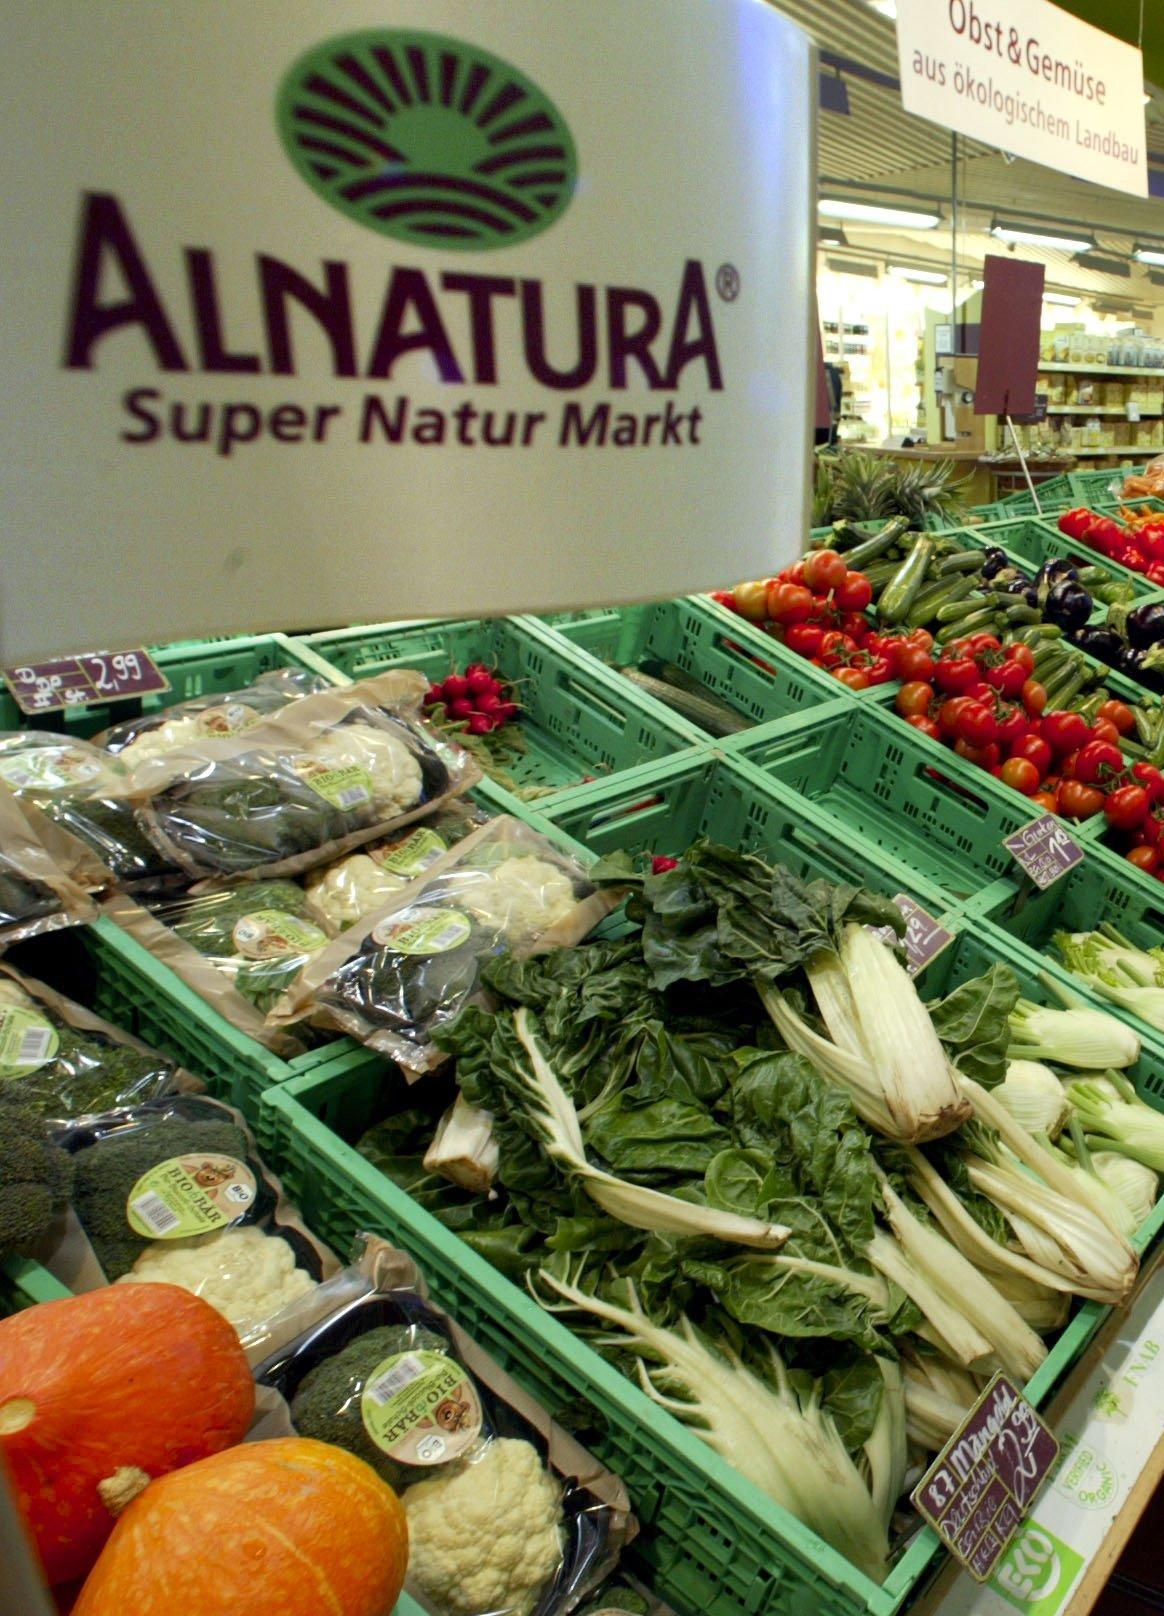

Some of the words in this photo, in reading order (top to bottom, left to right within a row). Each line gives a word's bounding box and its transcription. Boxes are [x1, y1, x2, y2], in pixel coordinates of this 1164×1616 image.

[913, 49, 946, 86] aus
[953, 62, 1070, 141] ökologischem
[1075, 119, 1138, 165] Landbau
[61, 189, 724, 391] ALNATURA
[121, 388, 340, 457] Super
[358, 395, 545, 448] Natur
[557, 399, 703, 448] Markt
[168, 1167, 193, 1193] BIO
[427, 1374, 457, 1403] BIO
[1062, 1450, 1093, 1490] VERIFIED
[1078, 1461, 1113, 1502] ORGANIC
[997, 1529, 1053, 1599] EKO
